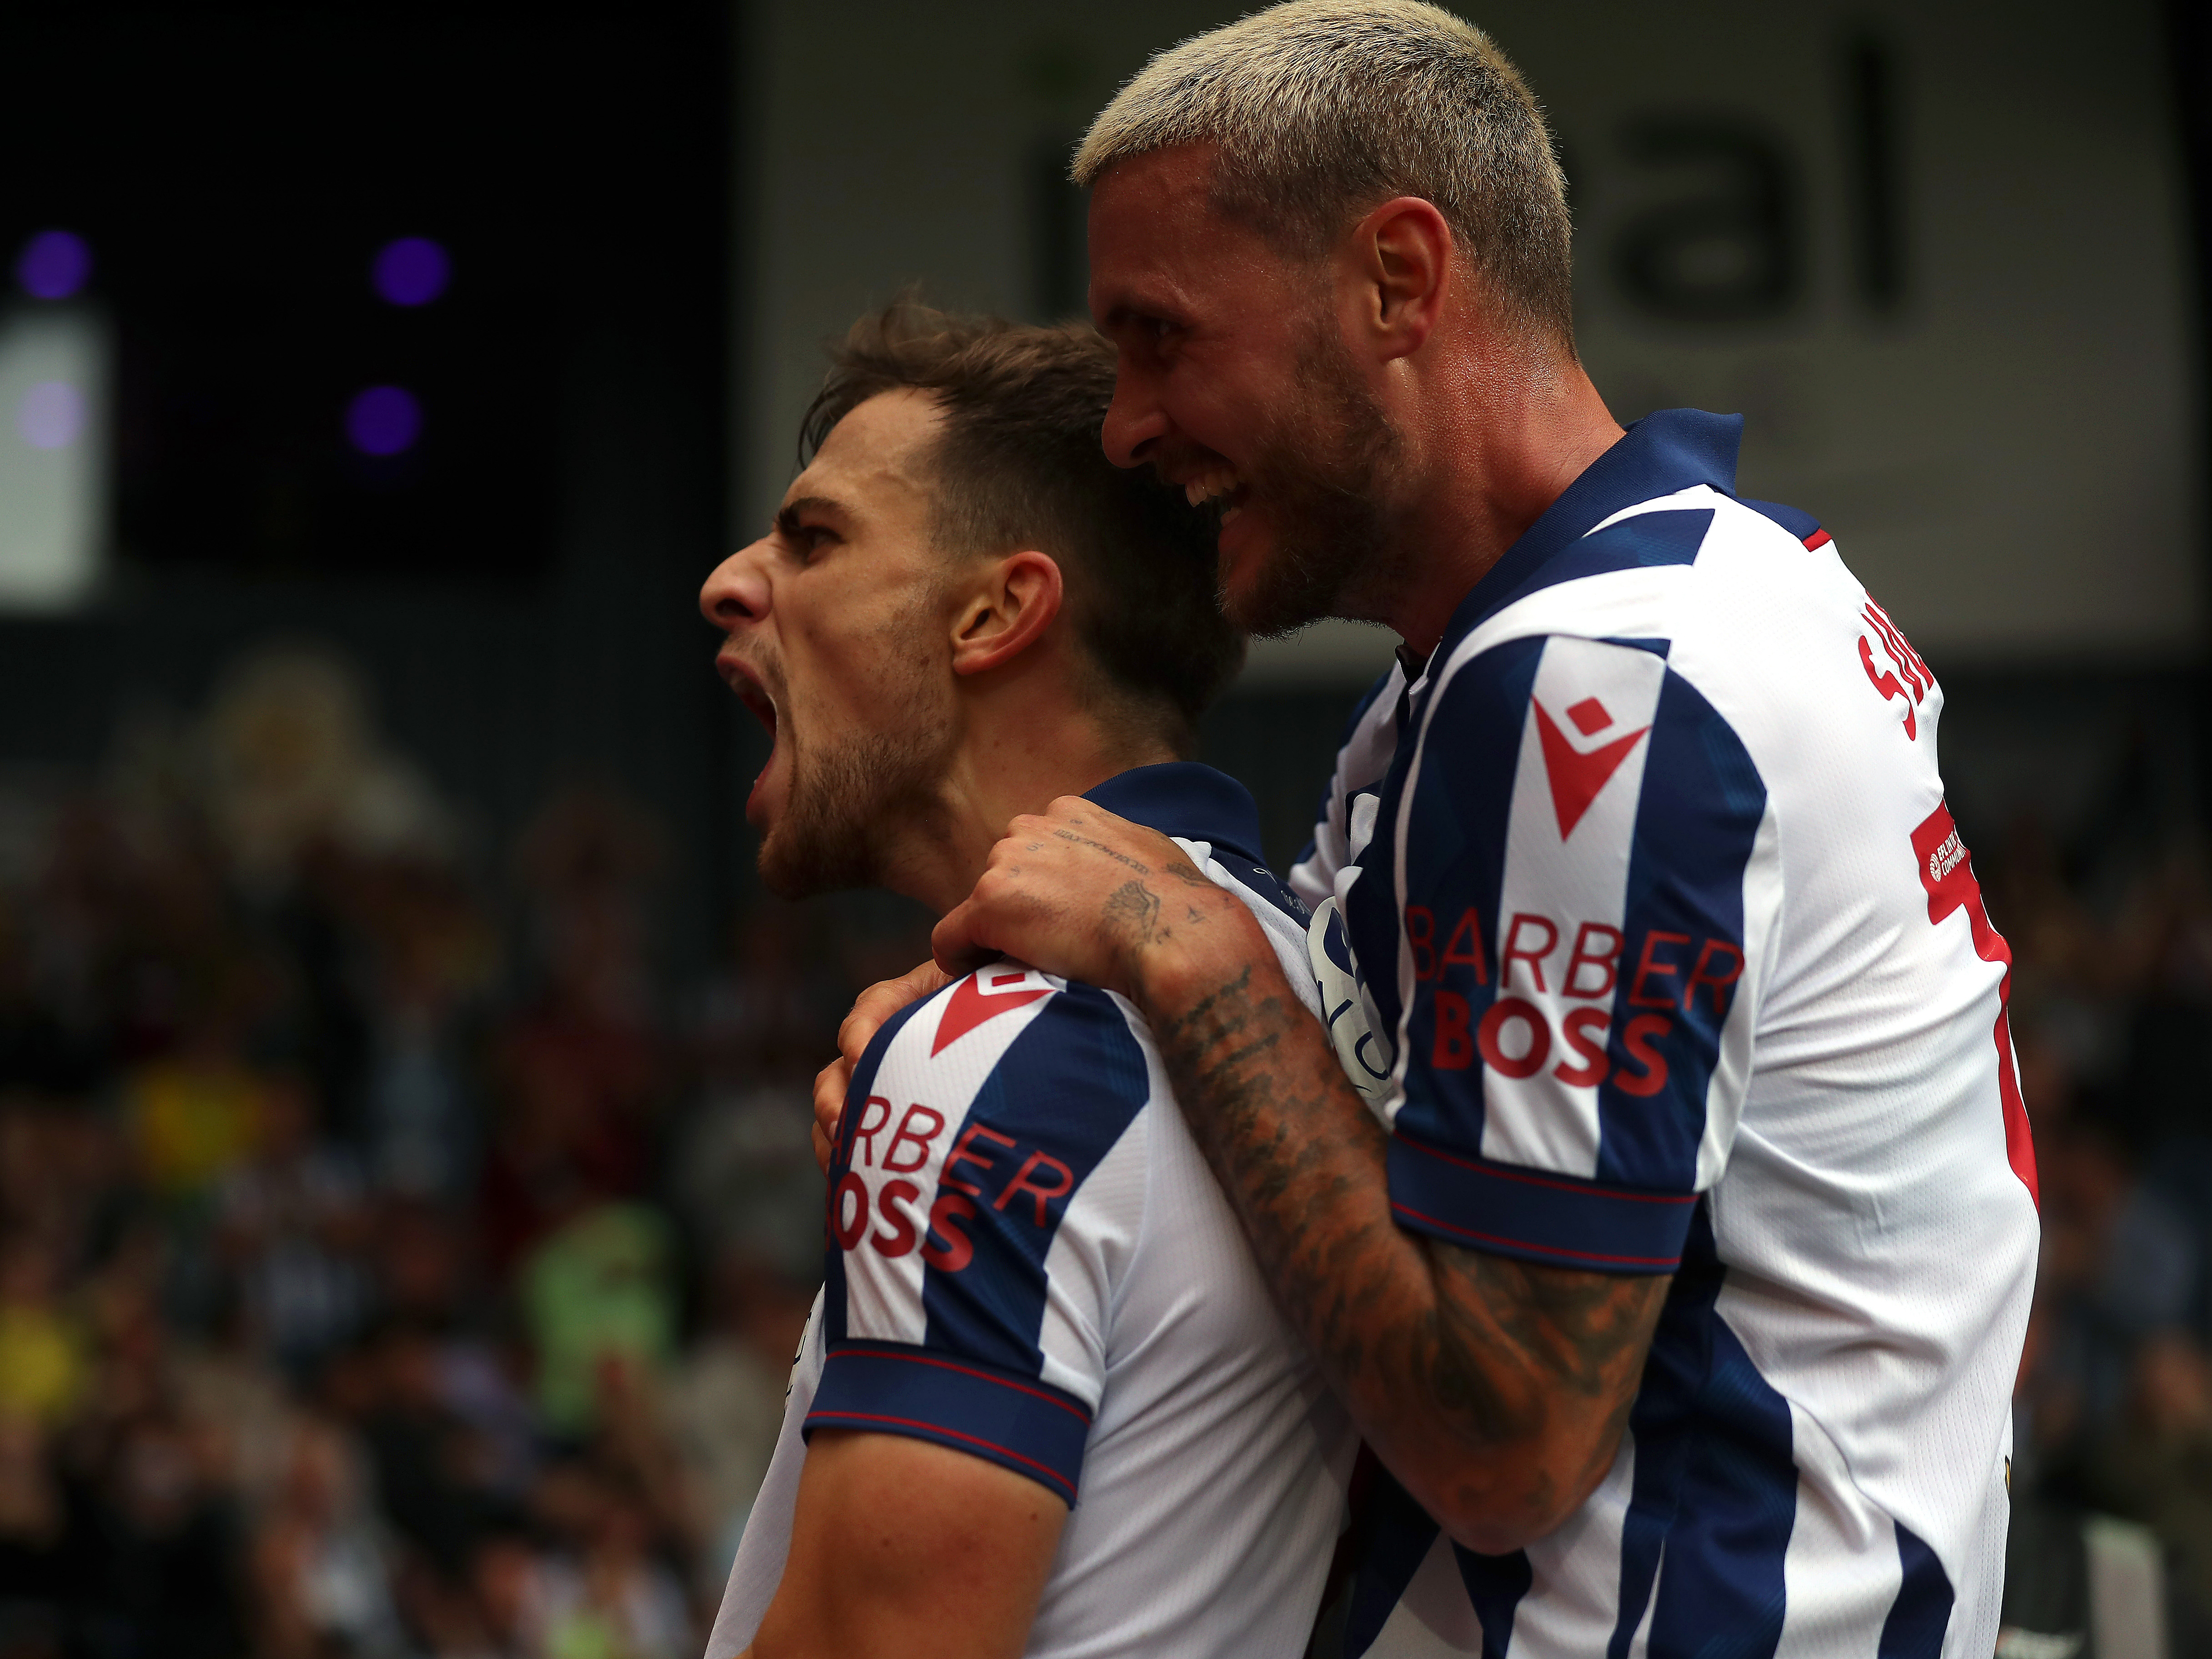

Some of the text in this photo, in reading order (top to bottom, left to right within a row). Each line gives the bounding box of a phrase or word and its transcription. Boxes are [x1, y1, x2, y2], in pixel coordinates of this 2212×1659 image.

[1937, 843, 1949, 861] EFL
[1406, 905, 1744, 1014] BARBER
[1432, 990, 1673, 1097] BOSS
[825, 1172, 976, 1273] OSS
